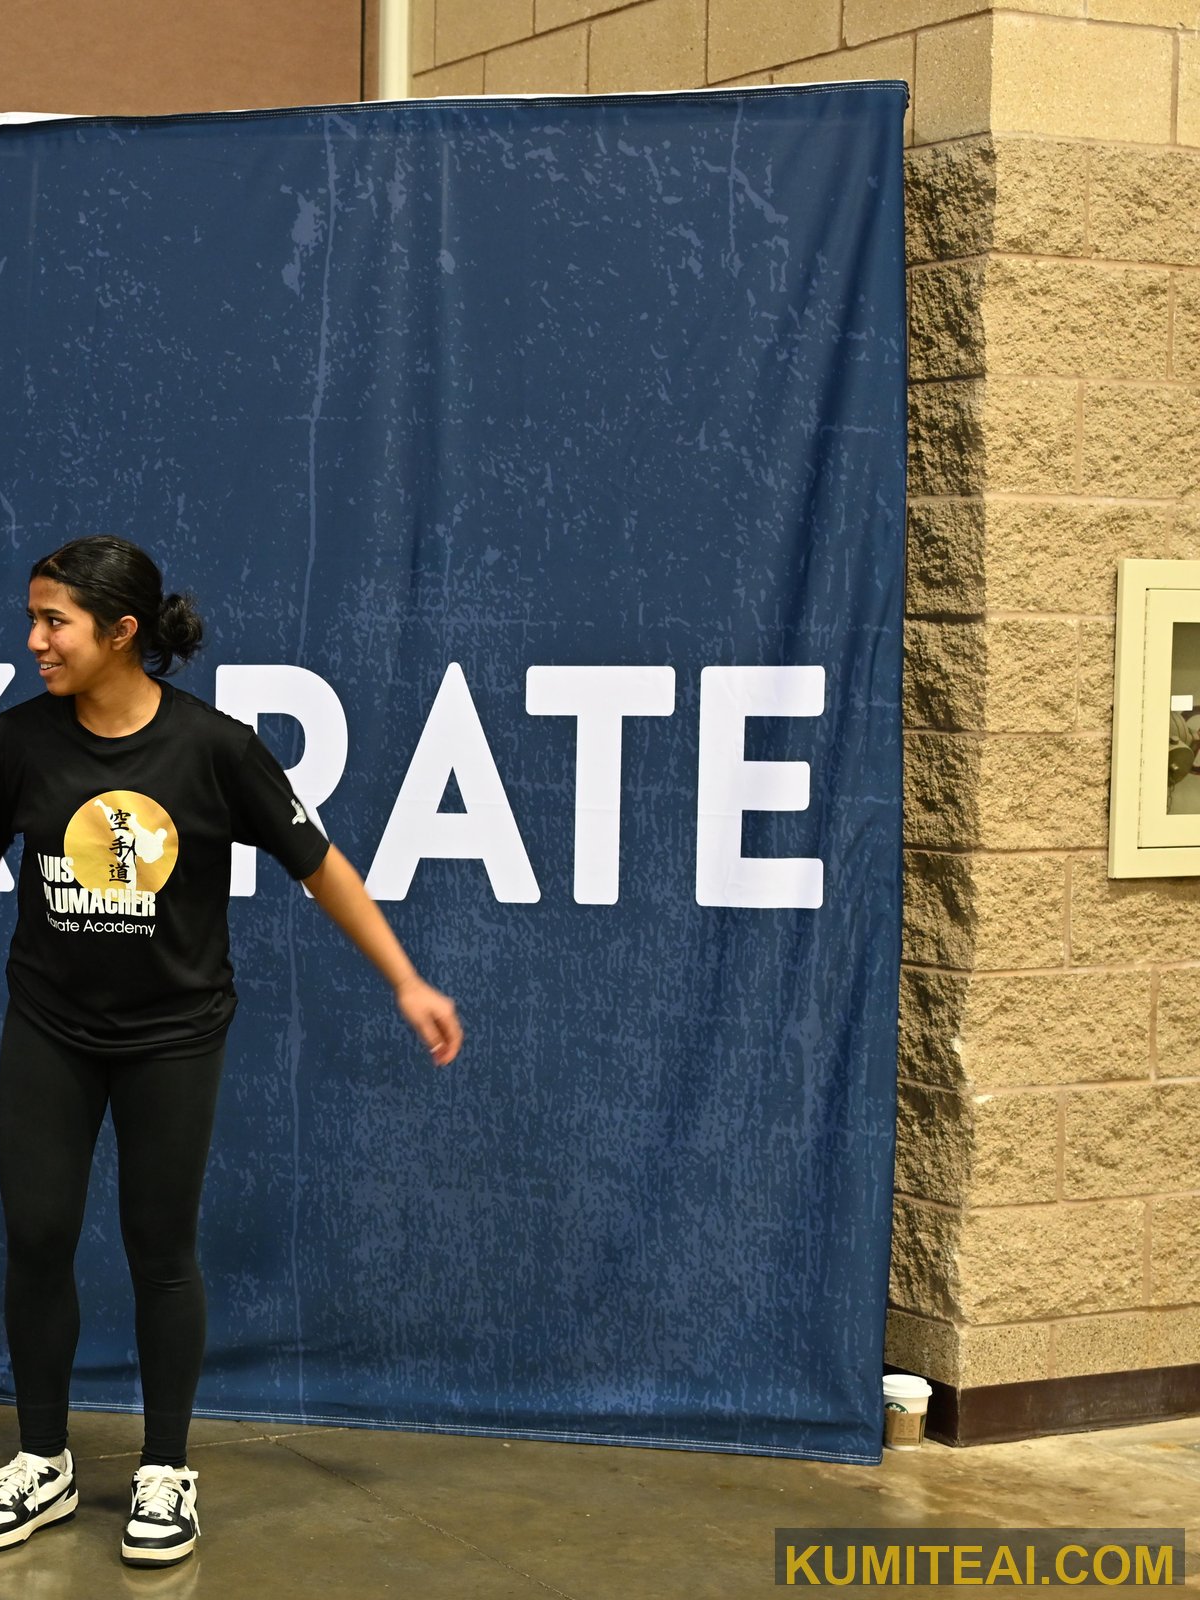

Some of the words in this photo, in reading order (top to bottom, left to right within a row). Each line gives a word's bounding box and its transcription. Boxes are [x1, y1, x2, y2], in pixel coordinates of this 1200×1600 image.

[108, 808, 132, 884] 空手道
[37, 852, 75, 884] LUIS
[82, 919, 156, 938] Academy
